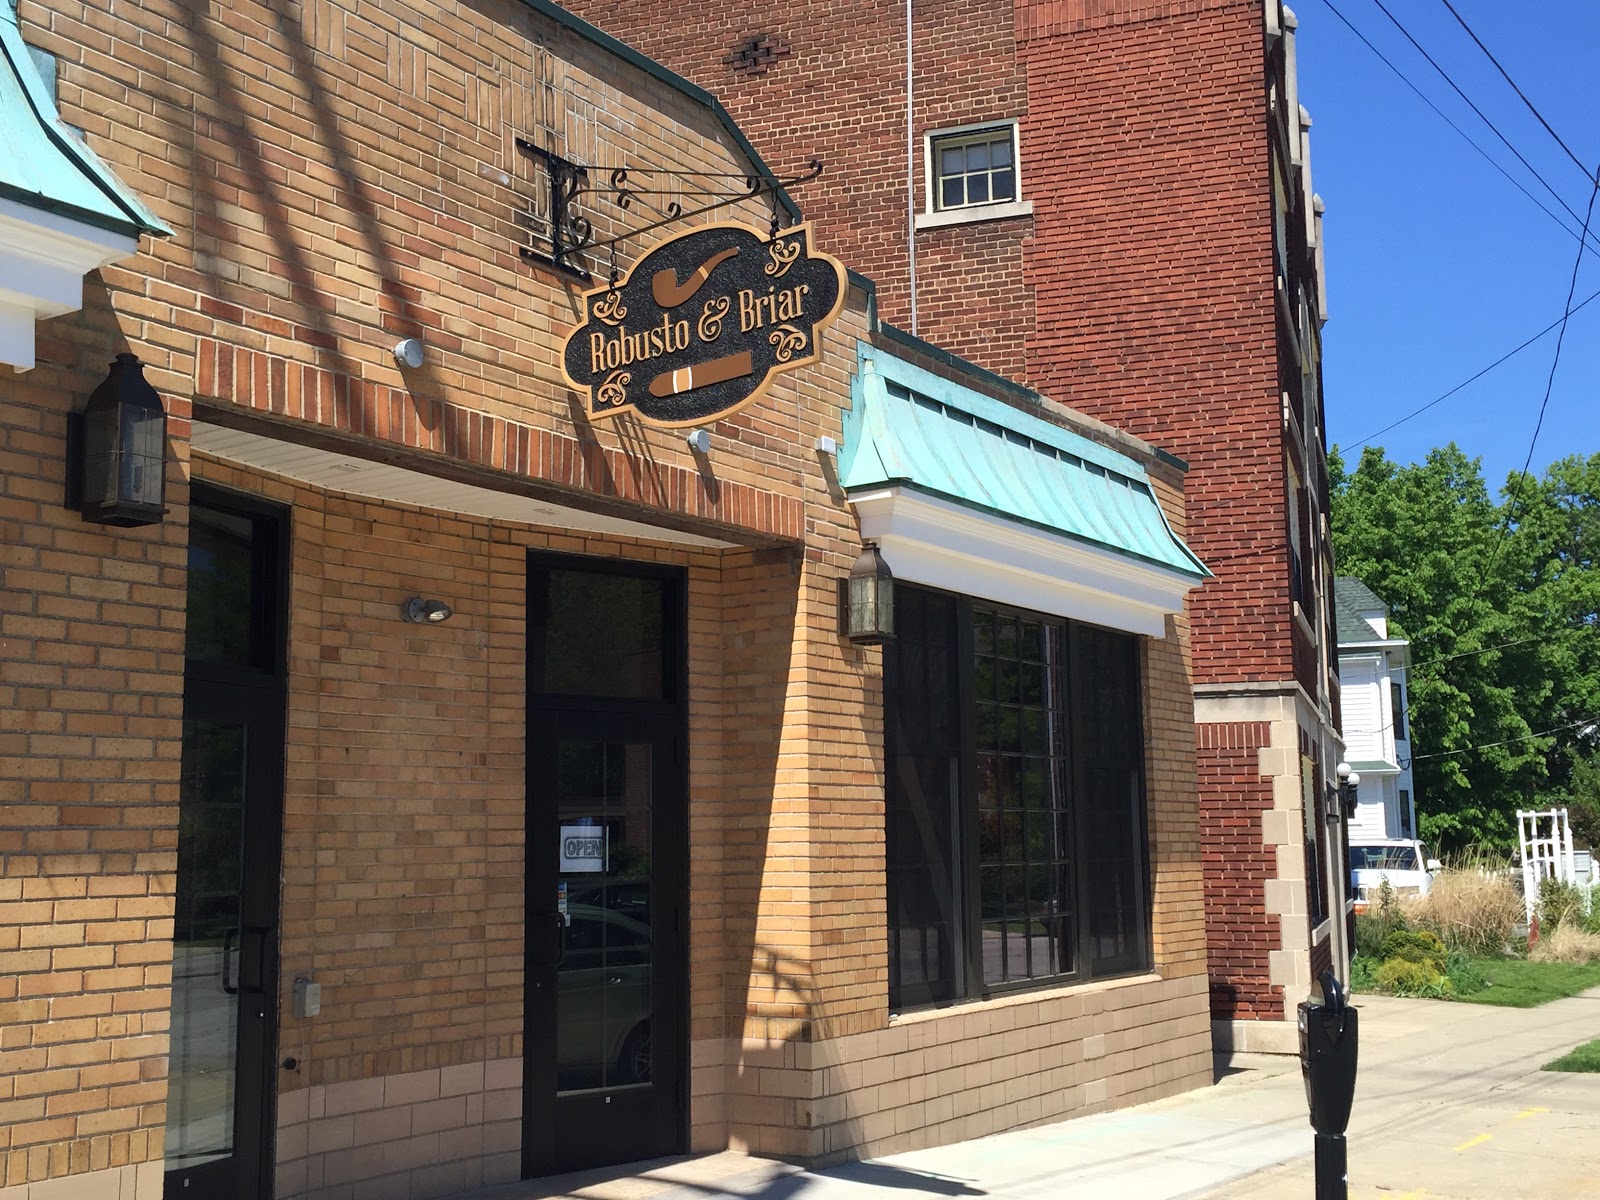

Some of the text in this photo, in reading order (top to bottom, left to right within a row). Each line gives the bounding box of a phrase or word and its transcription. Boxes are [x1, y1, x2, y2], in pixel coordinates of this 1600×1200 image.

[590, 284, 809, 373] Robusto & Briar
[567, 840, 602, 857] OPEN
